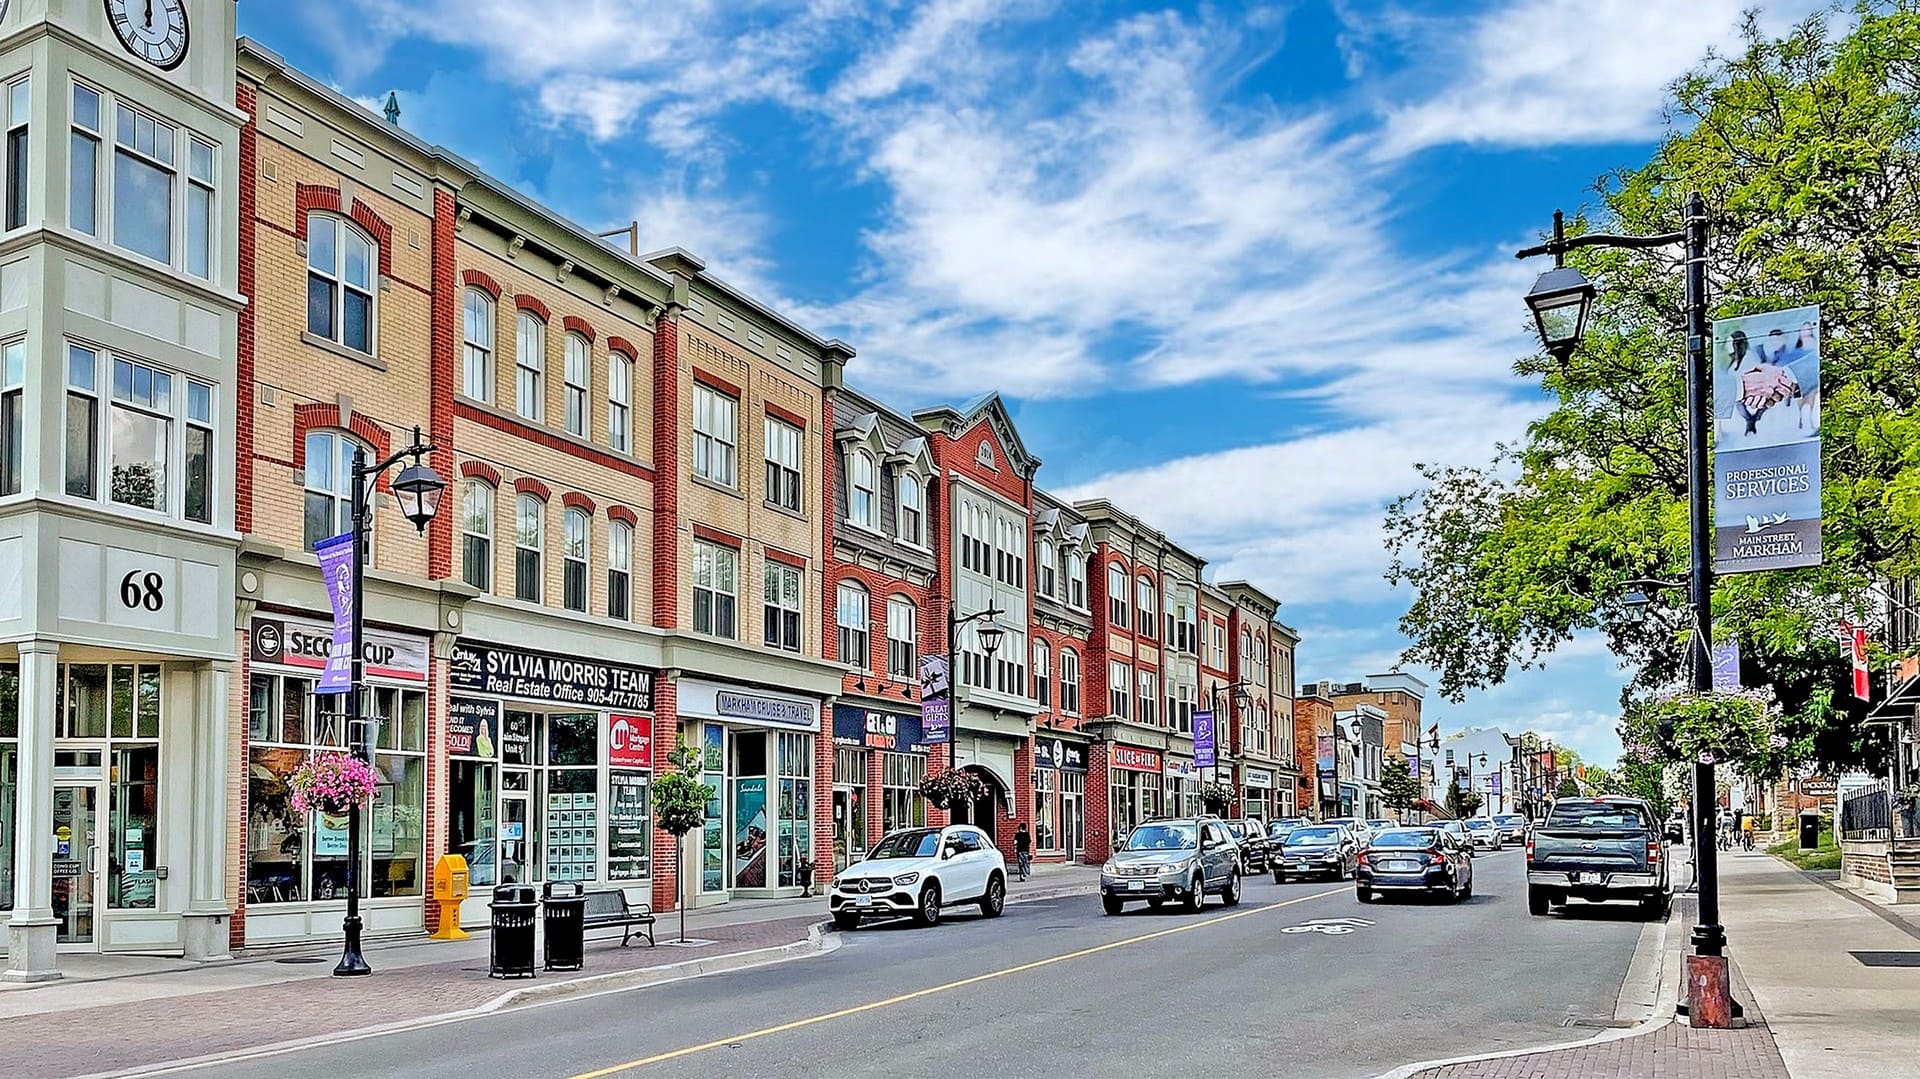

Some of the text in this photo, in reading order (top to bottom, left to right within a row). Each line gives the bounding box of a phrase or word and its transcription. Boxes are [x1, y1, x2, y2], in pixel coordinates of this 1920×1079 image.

[1726, 464, 1809, 481] PROFESSIONAL
[1726, 475, 1809, 499] SERVICES
[1739, 532, 1796, 545] MAIN STREET
[1733, 541, 1803, 558] MARKHAM
[120, 569, 164, 612] 68
[362, 641, 395, 665] CUP
[487, 651, 650, 693] SYLVIA MORRIS TEAM
[486, 676, 514, 694] Real
[515, 680, 551, 698] Estate
[552, 683, 585, 701] Office
[587, 687, 650, 710] 905-477-7785
[460, 704, 475, 714] with
[475, 705, 496, 717] Sylvia
[721, 695, 757, 713] MARKHAM
[757, 701, 780, 716] CRUISE
[787, 705, 811, 721] TRAVEL
[925, 705, 949, 713] GREAT
[925, 713, 949, 721] GIFTS
[450, 725, 474, 734] ECOMES
[1116, 748, 1136, 765] SLICE
[1141, 752, 1155, 768] FIRE
